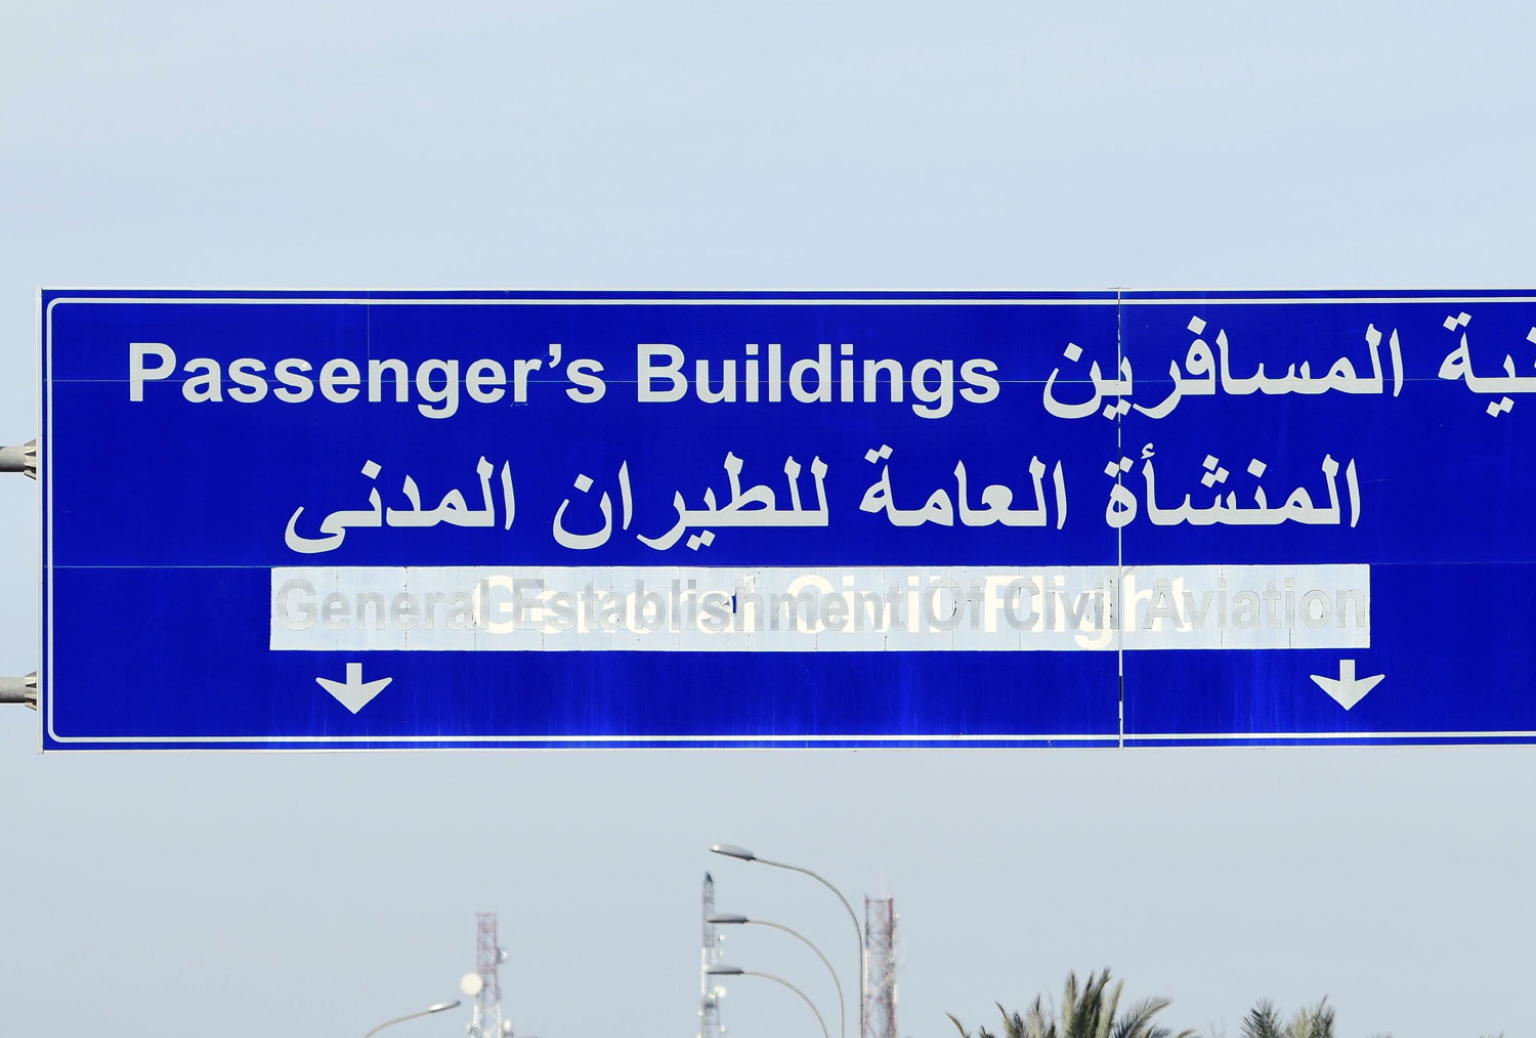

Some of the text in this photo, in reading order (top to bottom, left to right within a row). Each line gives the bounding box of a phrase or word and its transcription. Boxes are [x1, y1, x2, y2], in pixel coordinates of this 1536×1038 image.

[637, 343, 1002, 418] Buildings
[1042, 316, 1404, 419] المسافرين
[553, 452, 829, 550] للطيران
[859, 444, 1067, 530] العامة
[1105, 442, 1361, 530] المنشأة
